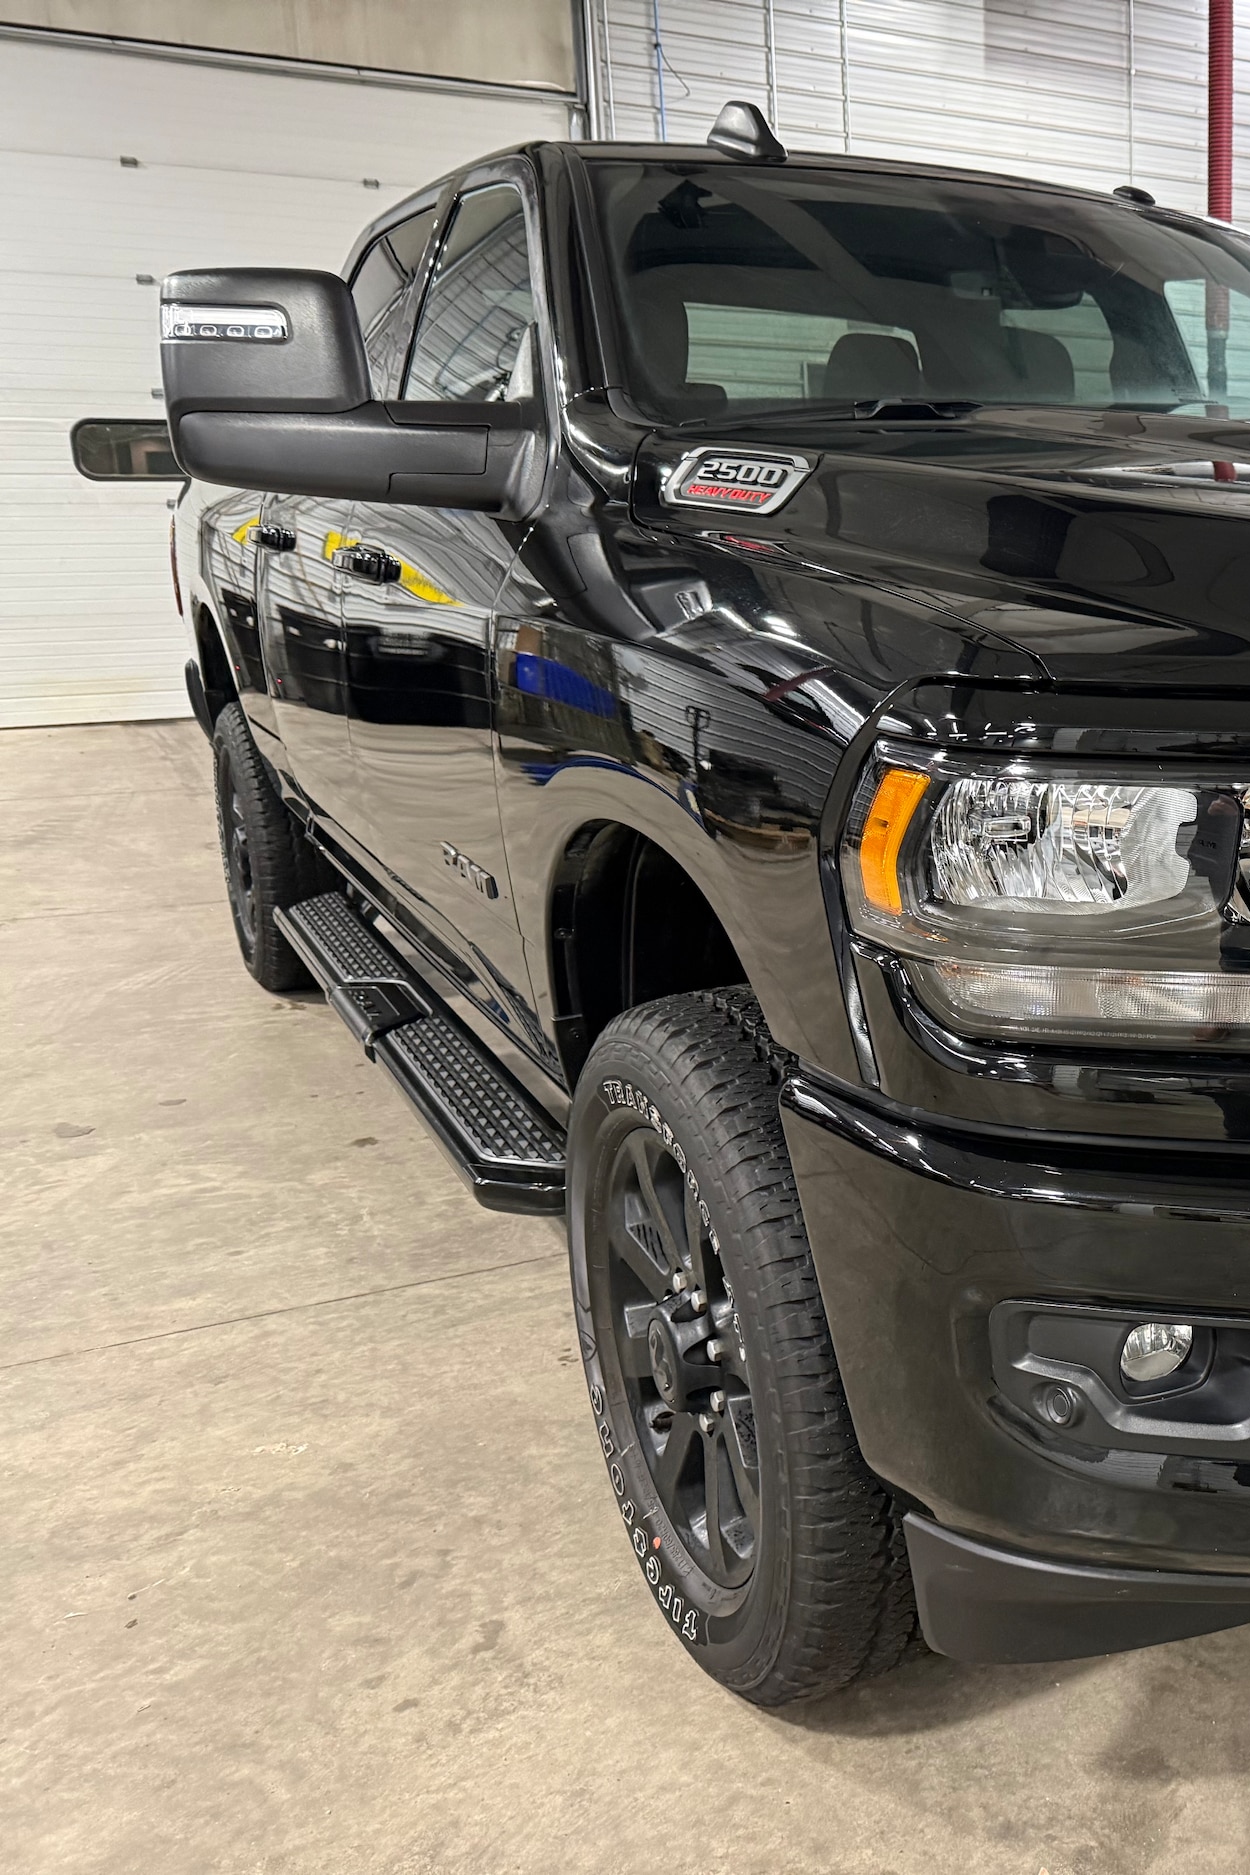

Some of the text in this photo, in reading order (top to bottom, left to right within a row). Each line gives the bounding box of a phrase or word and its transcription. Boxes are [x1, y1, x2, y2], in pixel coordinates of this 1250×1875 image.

[697, 461, 786, 486] 2500
[687, 484, 771, 503] HEAVY DUTY
[440, 841, 499, 899] RAM
